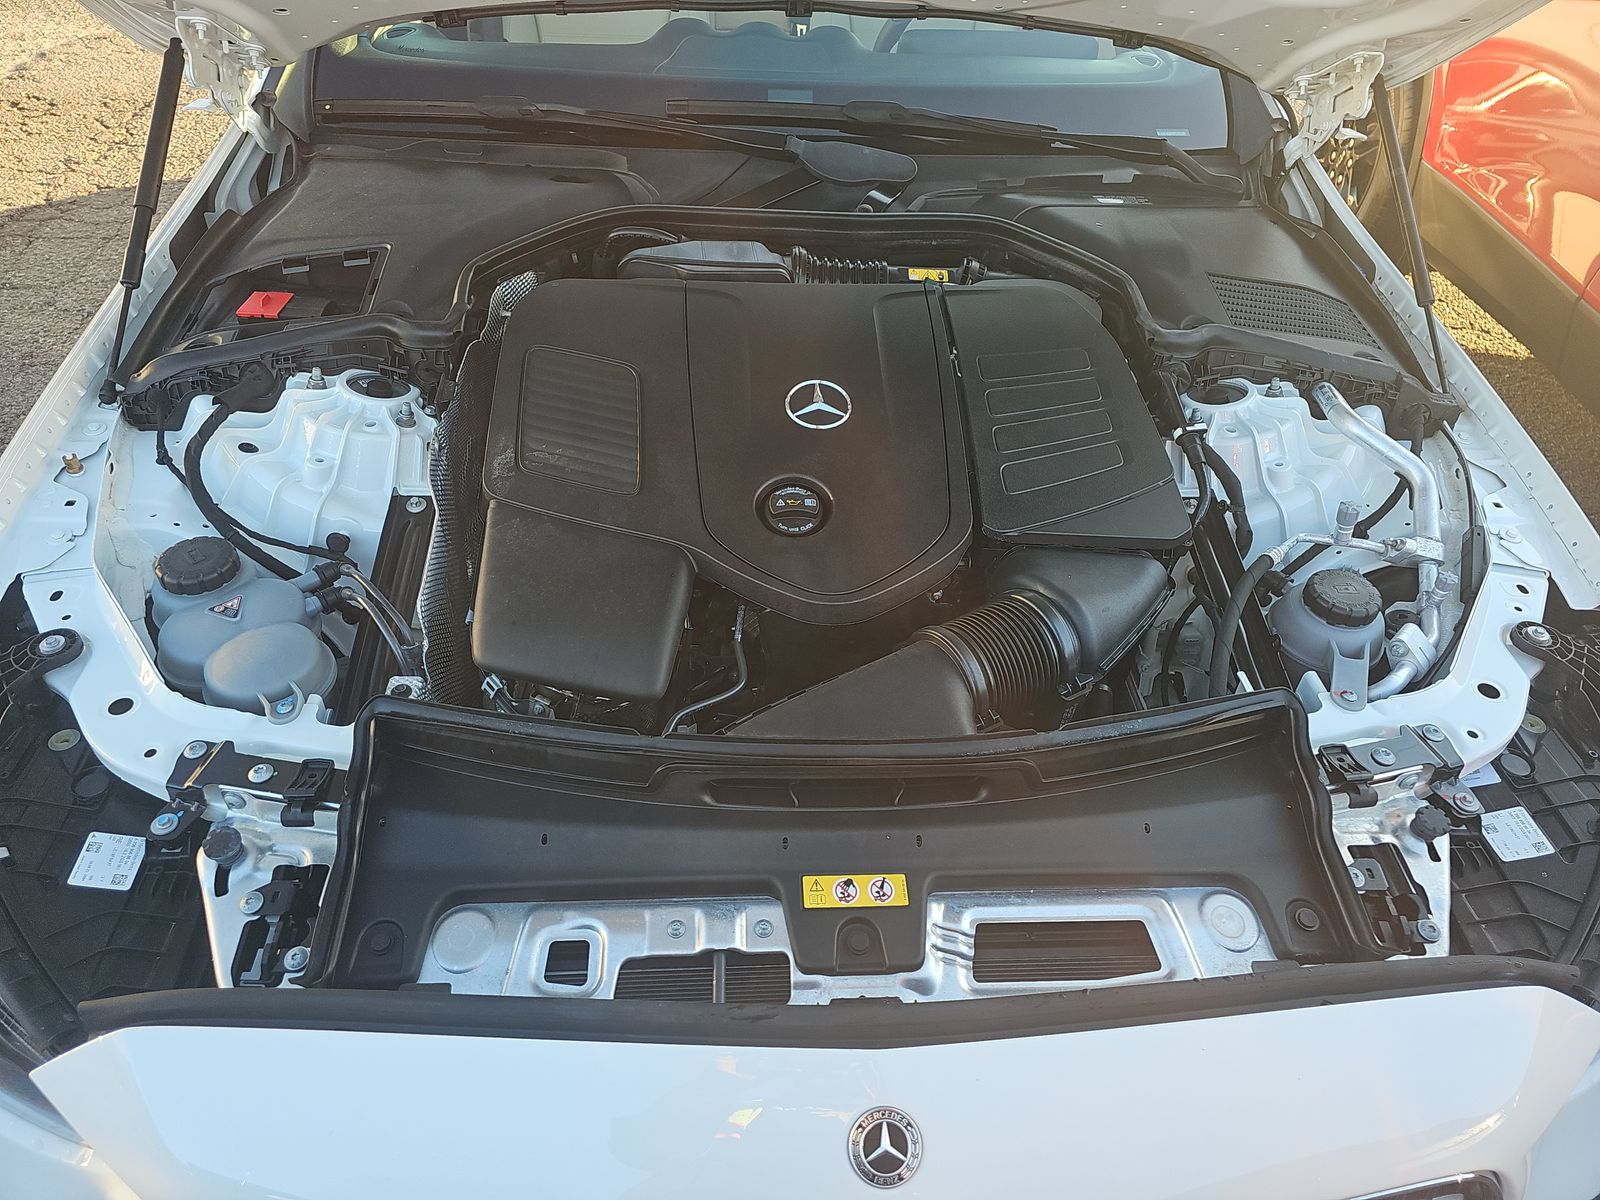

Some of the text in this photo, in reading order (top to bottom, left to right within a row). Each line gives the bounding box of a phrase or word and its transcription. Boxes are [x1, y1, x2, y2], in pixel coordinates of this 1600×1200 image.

[800, 522, 814, 531] CLICK
[861, 1110, 908, 1128] MERCEDES
[874, 1175, 900, 1185] BENZ
